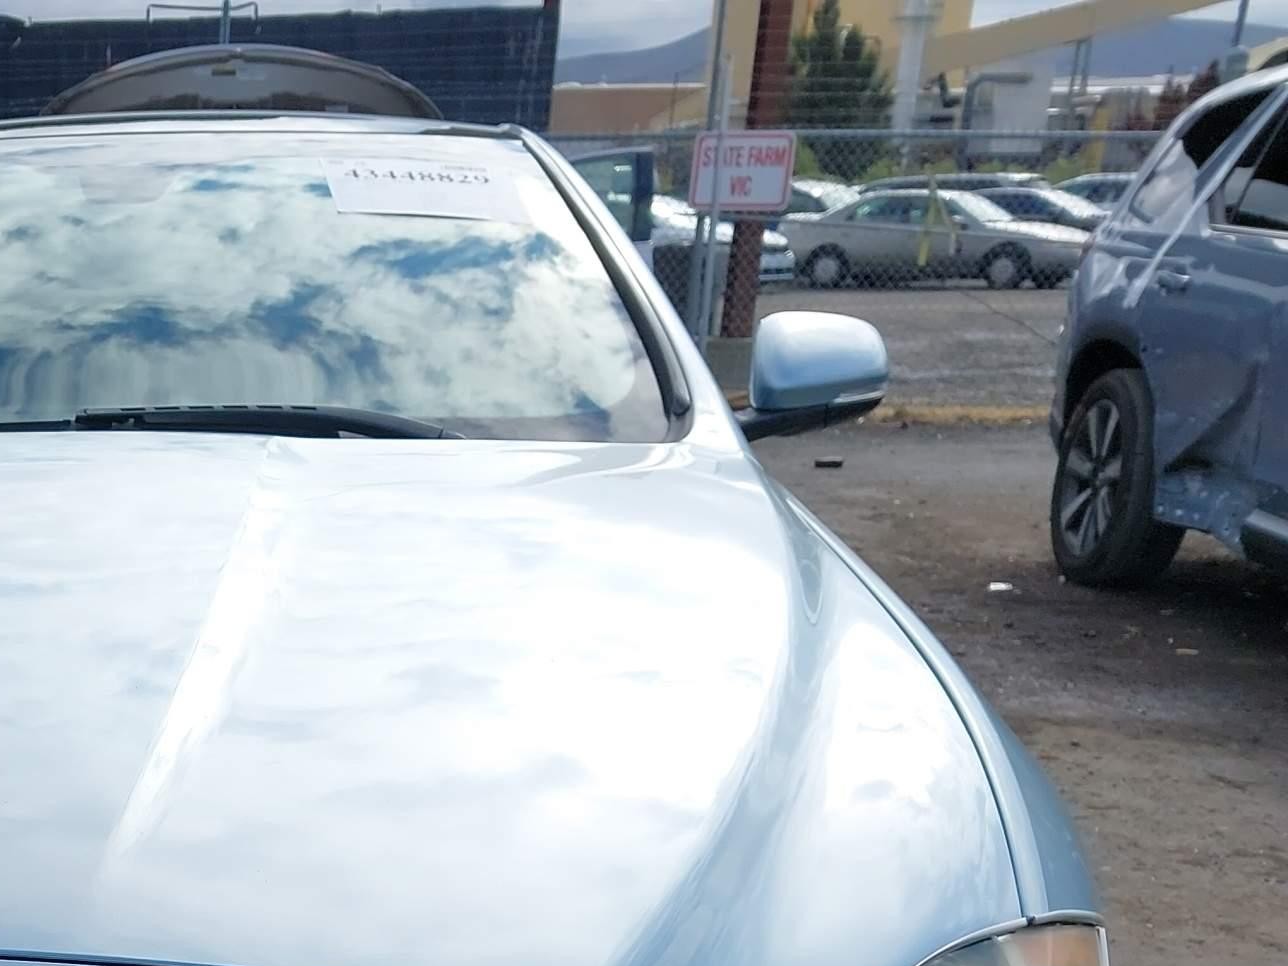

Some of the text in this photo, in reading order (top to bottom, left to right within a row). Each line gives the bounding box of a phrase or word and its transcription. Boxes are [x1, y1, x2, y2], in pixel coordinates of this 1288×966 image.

[703, 146, 786, 167] SATE FARM
[344, 168, 490, 185] 43448829
